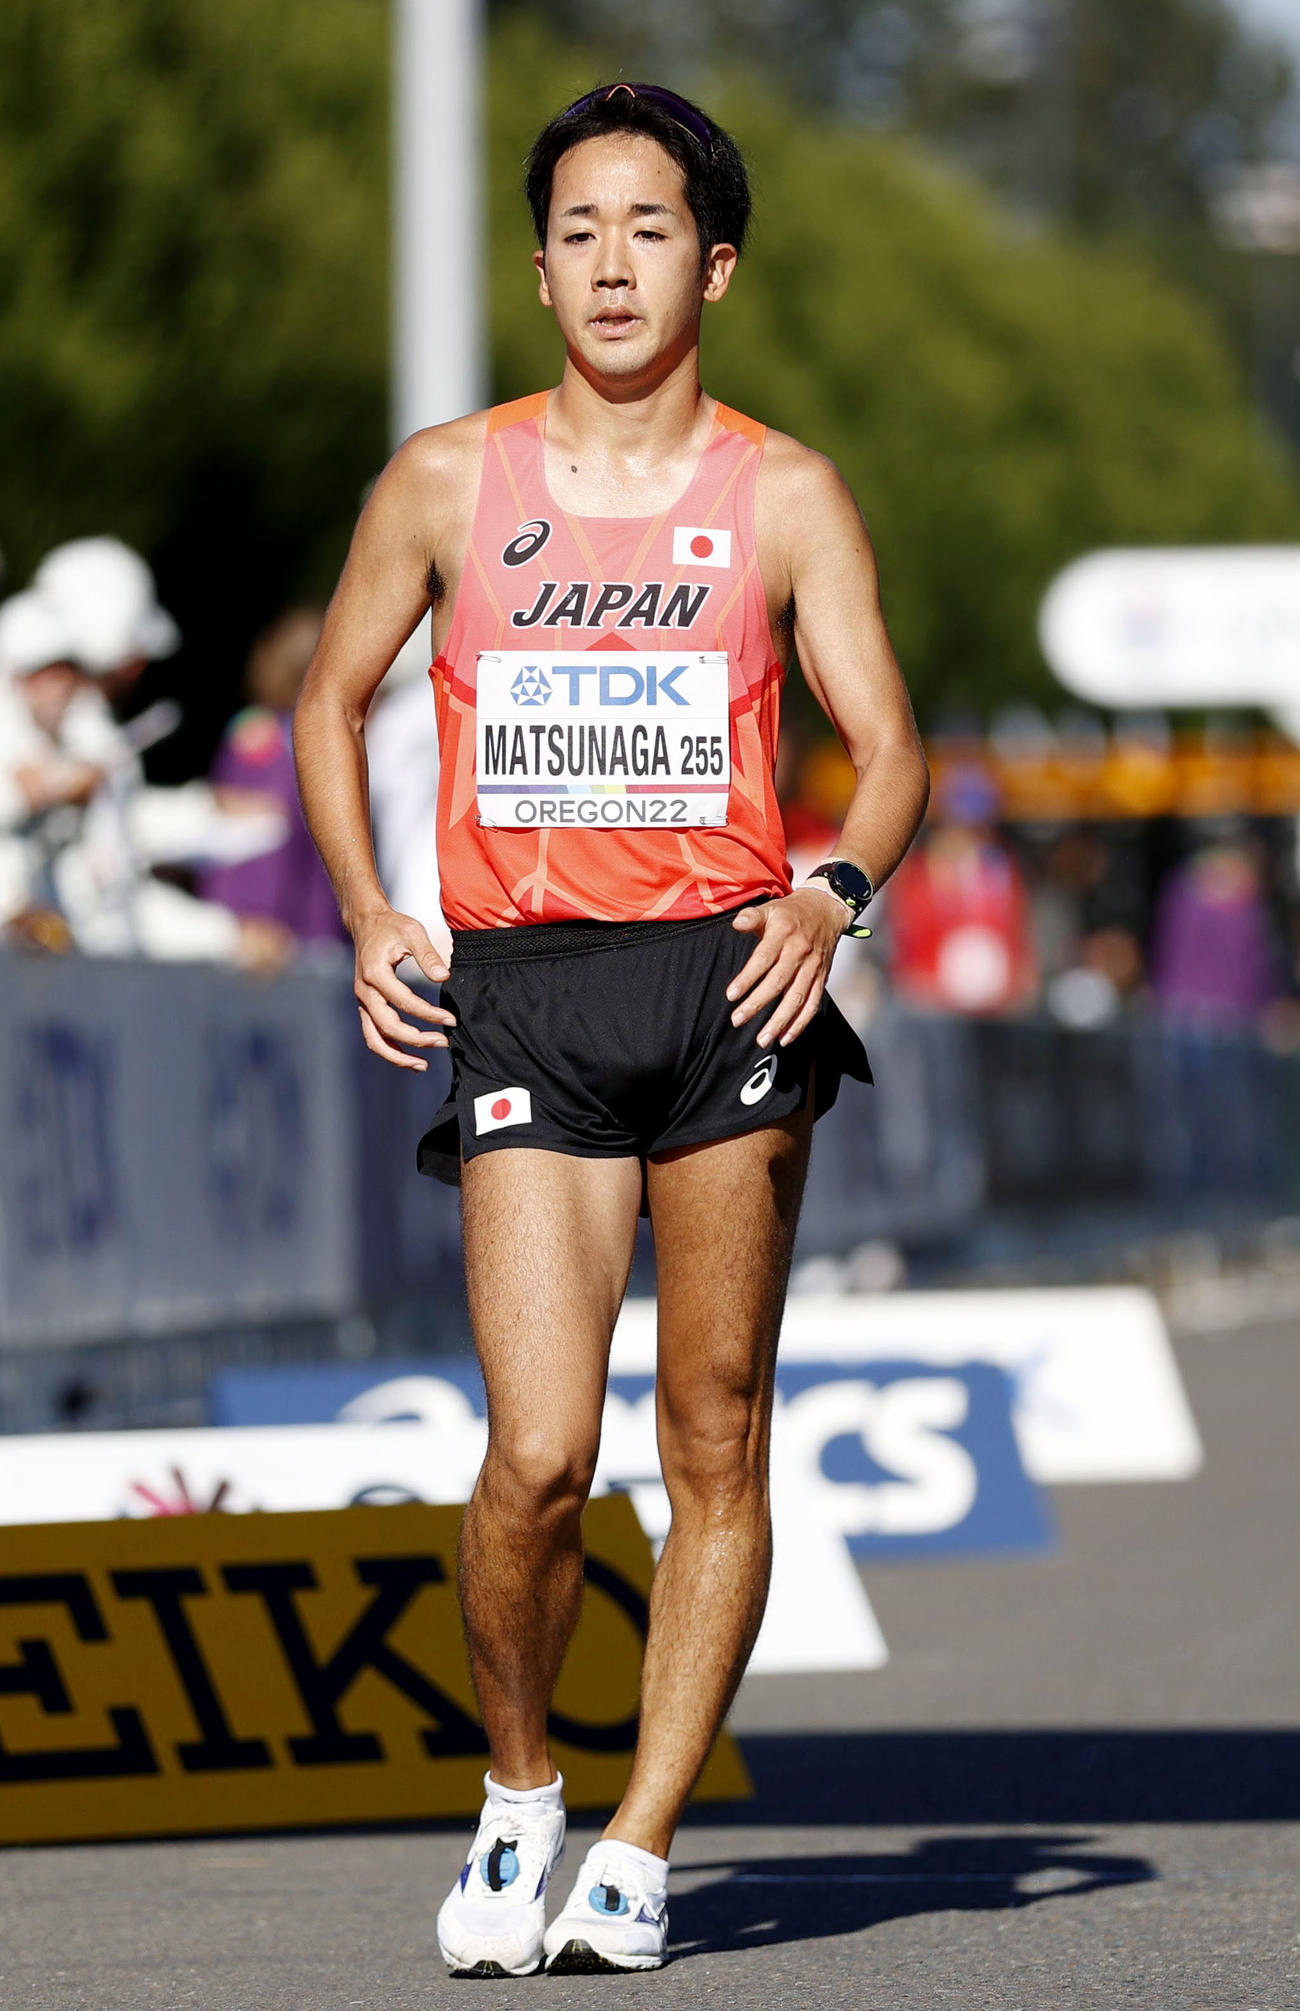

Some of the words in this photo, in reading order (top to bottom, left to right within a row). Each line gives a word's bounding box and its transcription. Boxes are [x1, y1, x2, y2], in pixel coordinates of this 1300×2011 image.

[511, 581, 711, 630] JAPAN
[552, 666, 691, 706] TDK
[484, 724, 672, 777] MATSUNAGA
[680, 735, 724, 776] 255
[515, 799, 689, 824] OREGON22
